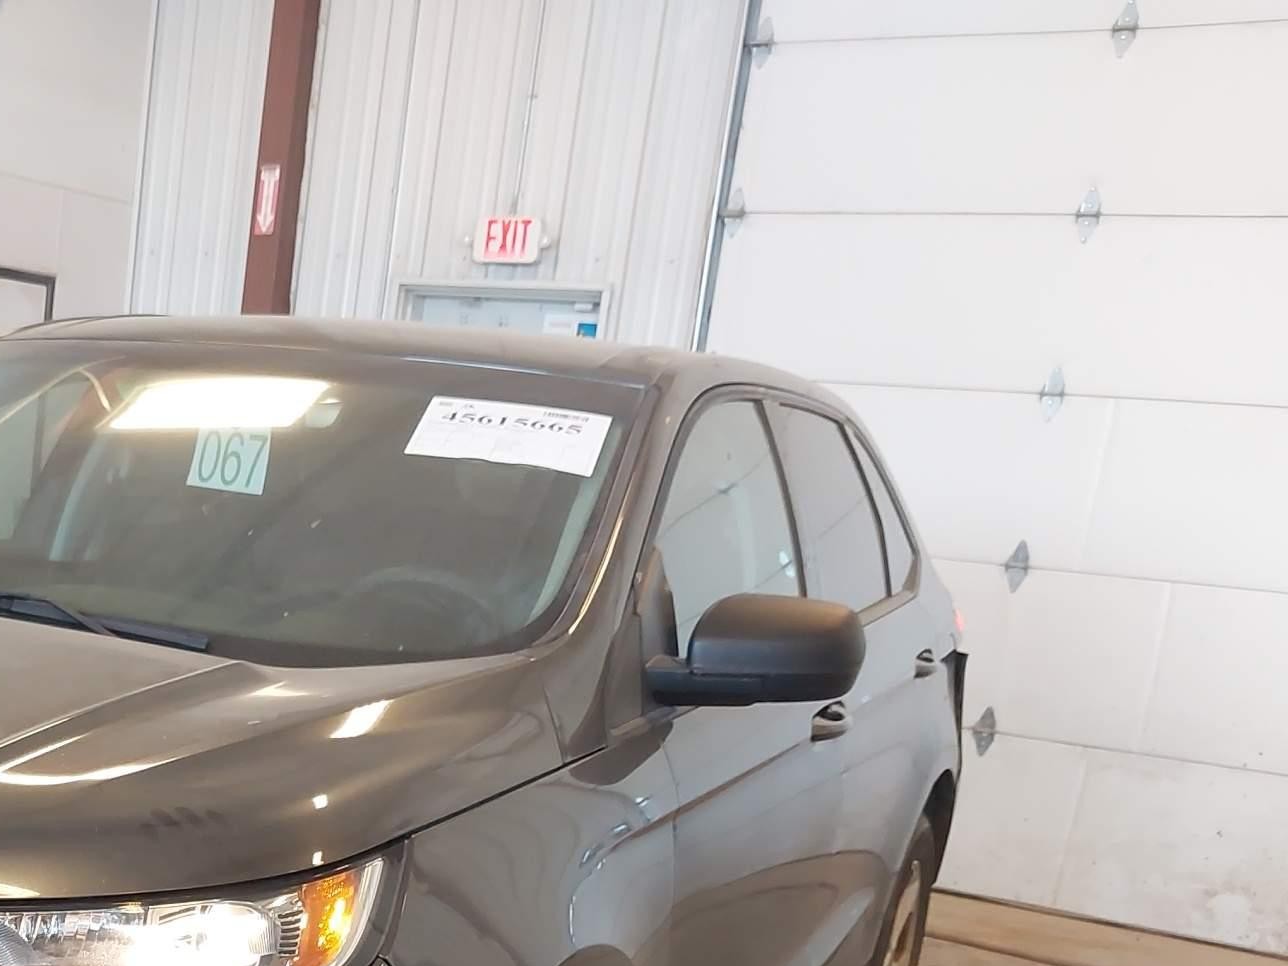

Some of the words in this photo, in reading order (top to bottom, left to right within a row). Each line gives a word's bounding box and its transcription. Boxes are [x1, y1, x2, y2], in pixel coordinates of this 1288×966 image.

[484, 218, 533, 257] EXIT
[441, 411, 583, 435] 45615665
[197, 429, 268, 488] 067
